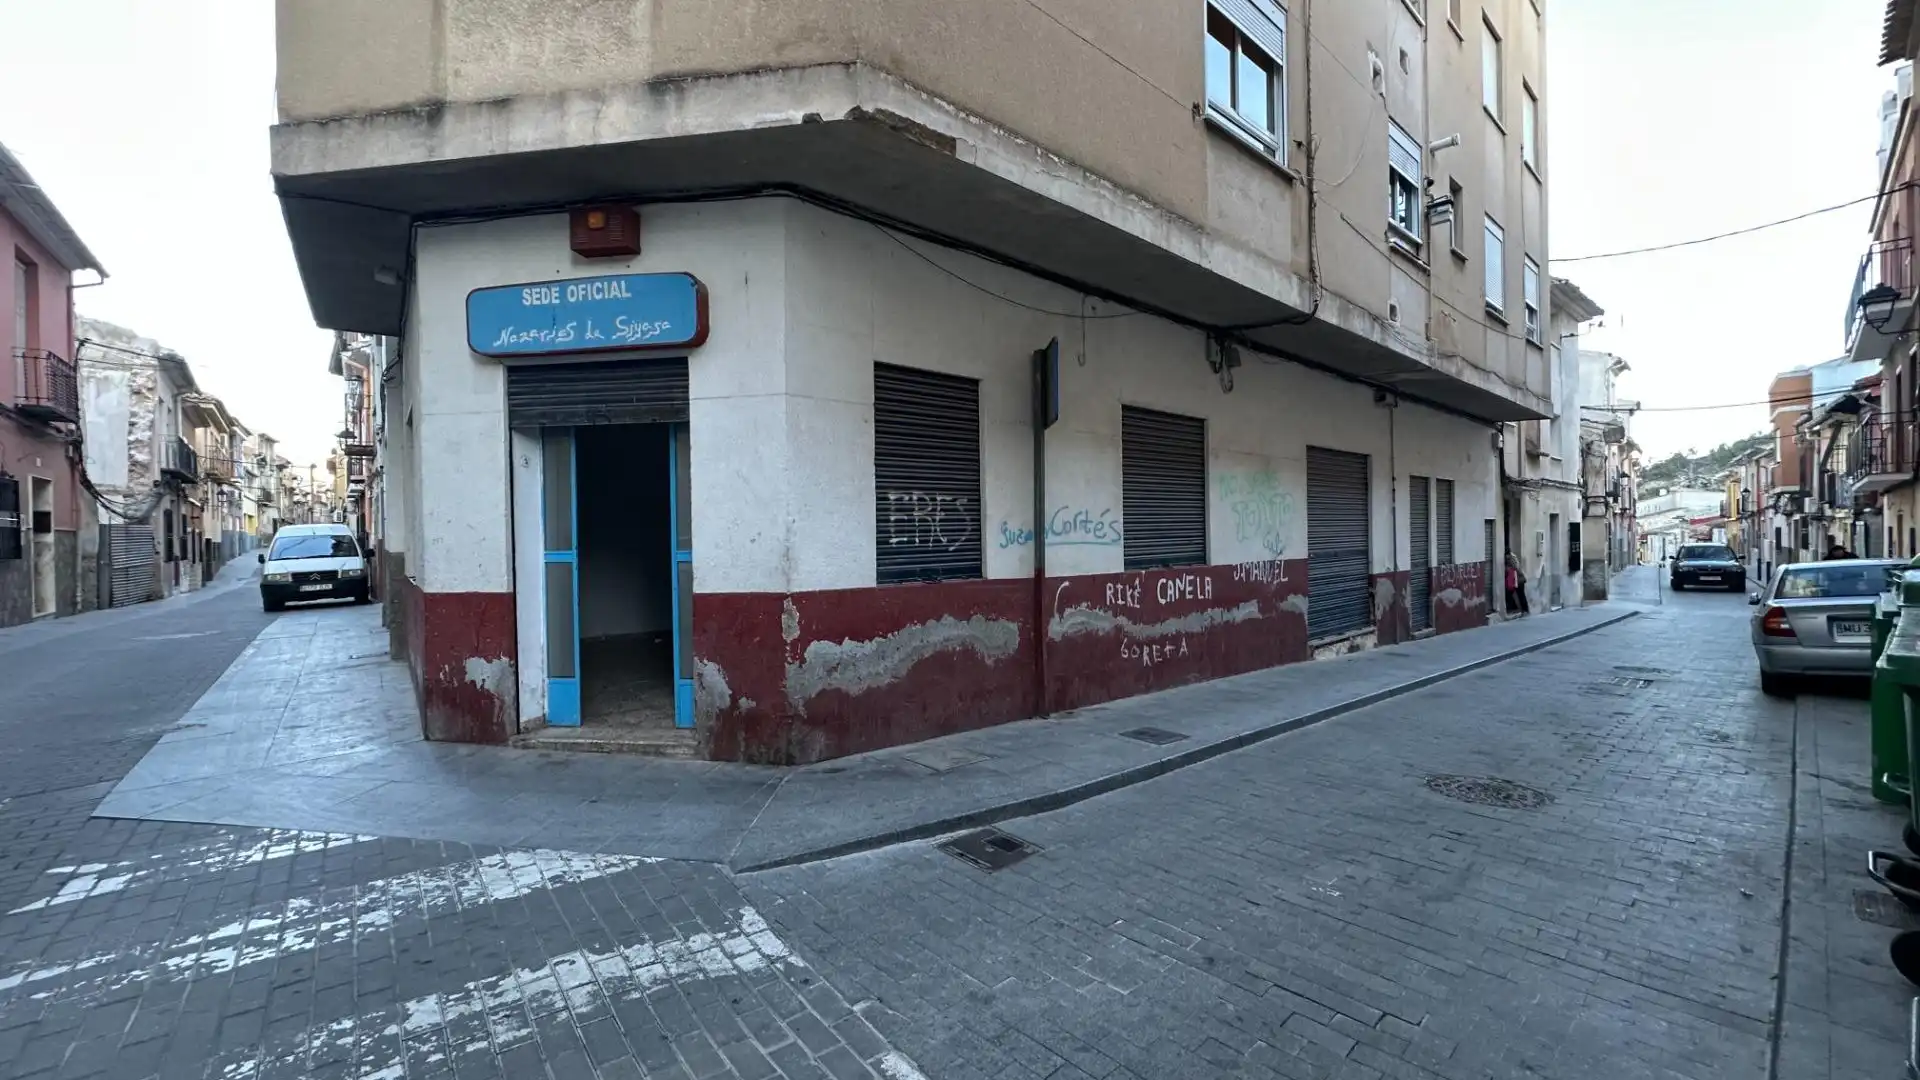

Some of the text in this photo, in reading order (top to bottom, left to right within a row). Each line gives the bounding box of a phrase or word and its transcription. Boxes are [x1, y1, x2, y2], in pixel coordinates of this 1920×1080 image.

[522, 280, 632, 306] SEDE OFICIAL
[888, 491, 972, 551] ERES
[1050, 505, 1122, 543] Cortés
[1156, 573, 1214, 605] CANELA
